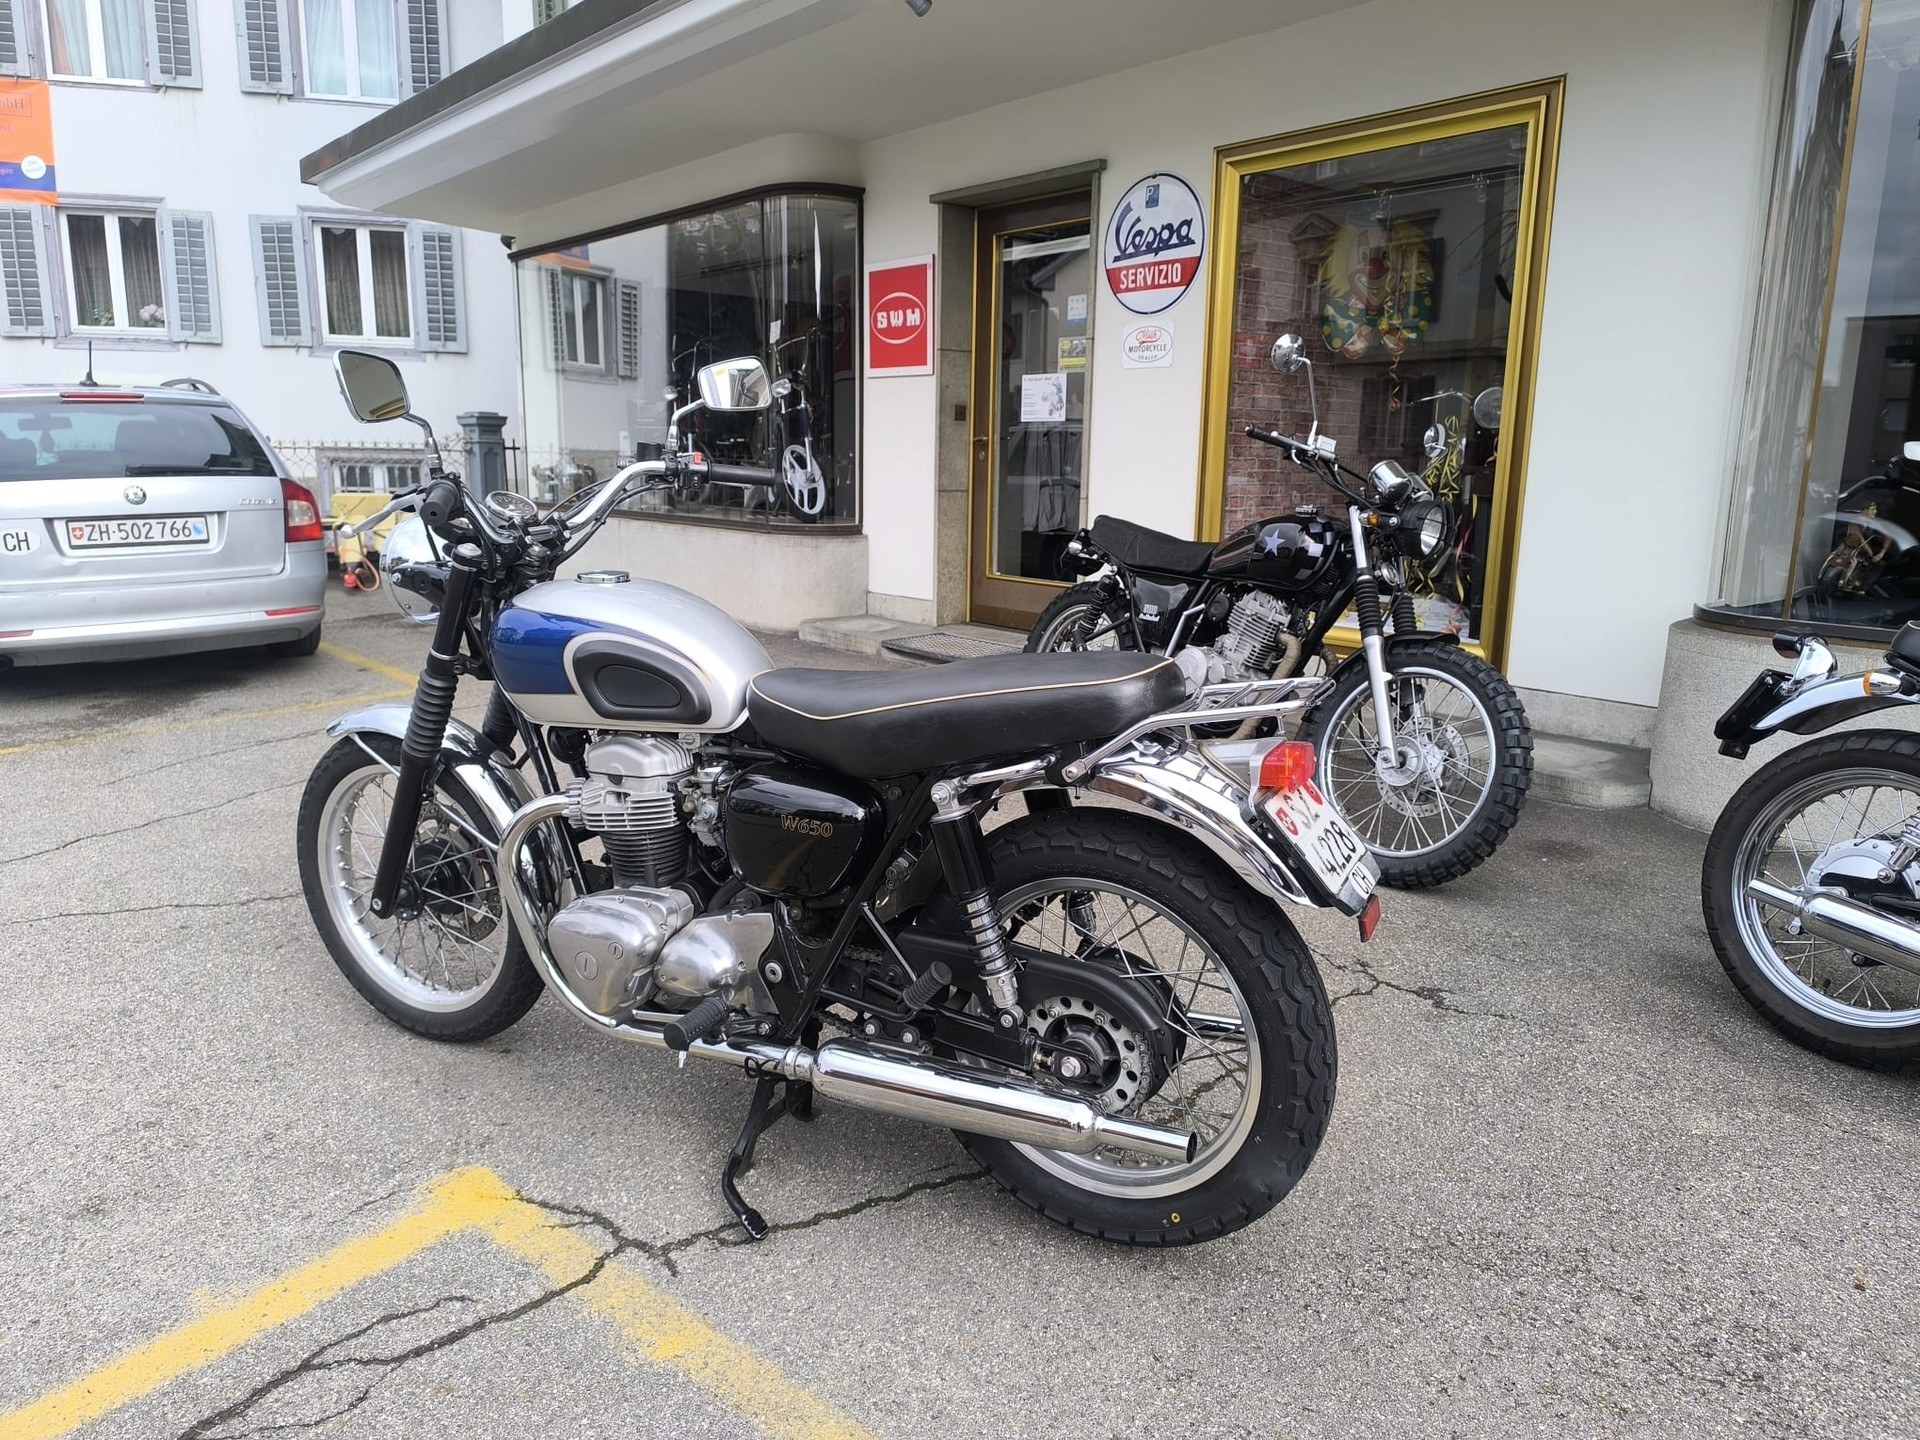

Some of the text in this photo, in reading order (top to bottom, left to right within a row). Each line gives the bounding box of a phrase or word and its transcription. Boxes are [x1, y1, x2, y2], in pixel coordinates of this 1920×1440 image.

[1112, 201, 1196, 263] Vespa
[1119, 262, 1182, 290] SERVIZIO
[876, 307, 921, 330] SWM
[1127, 343, 1168, 353] MOTORCYCLE
[3, 531, 31, 552] CH
[780, 814, 833, 838] W650
[1351, 865, 1374, 895] CH
